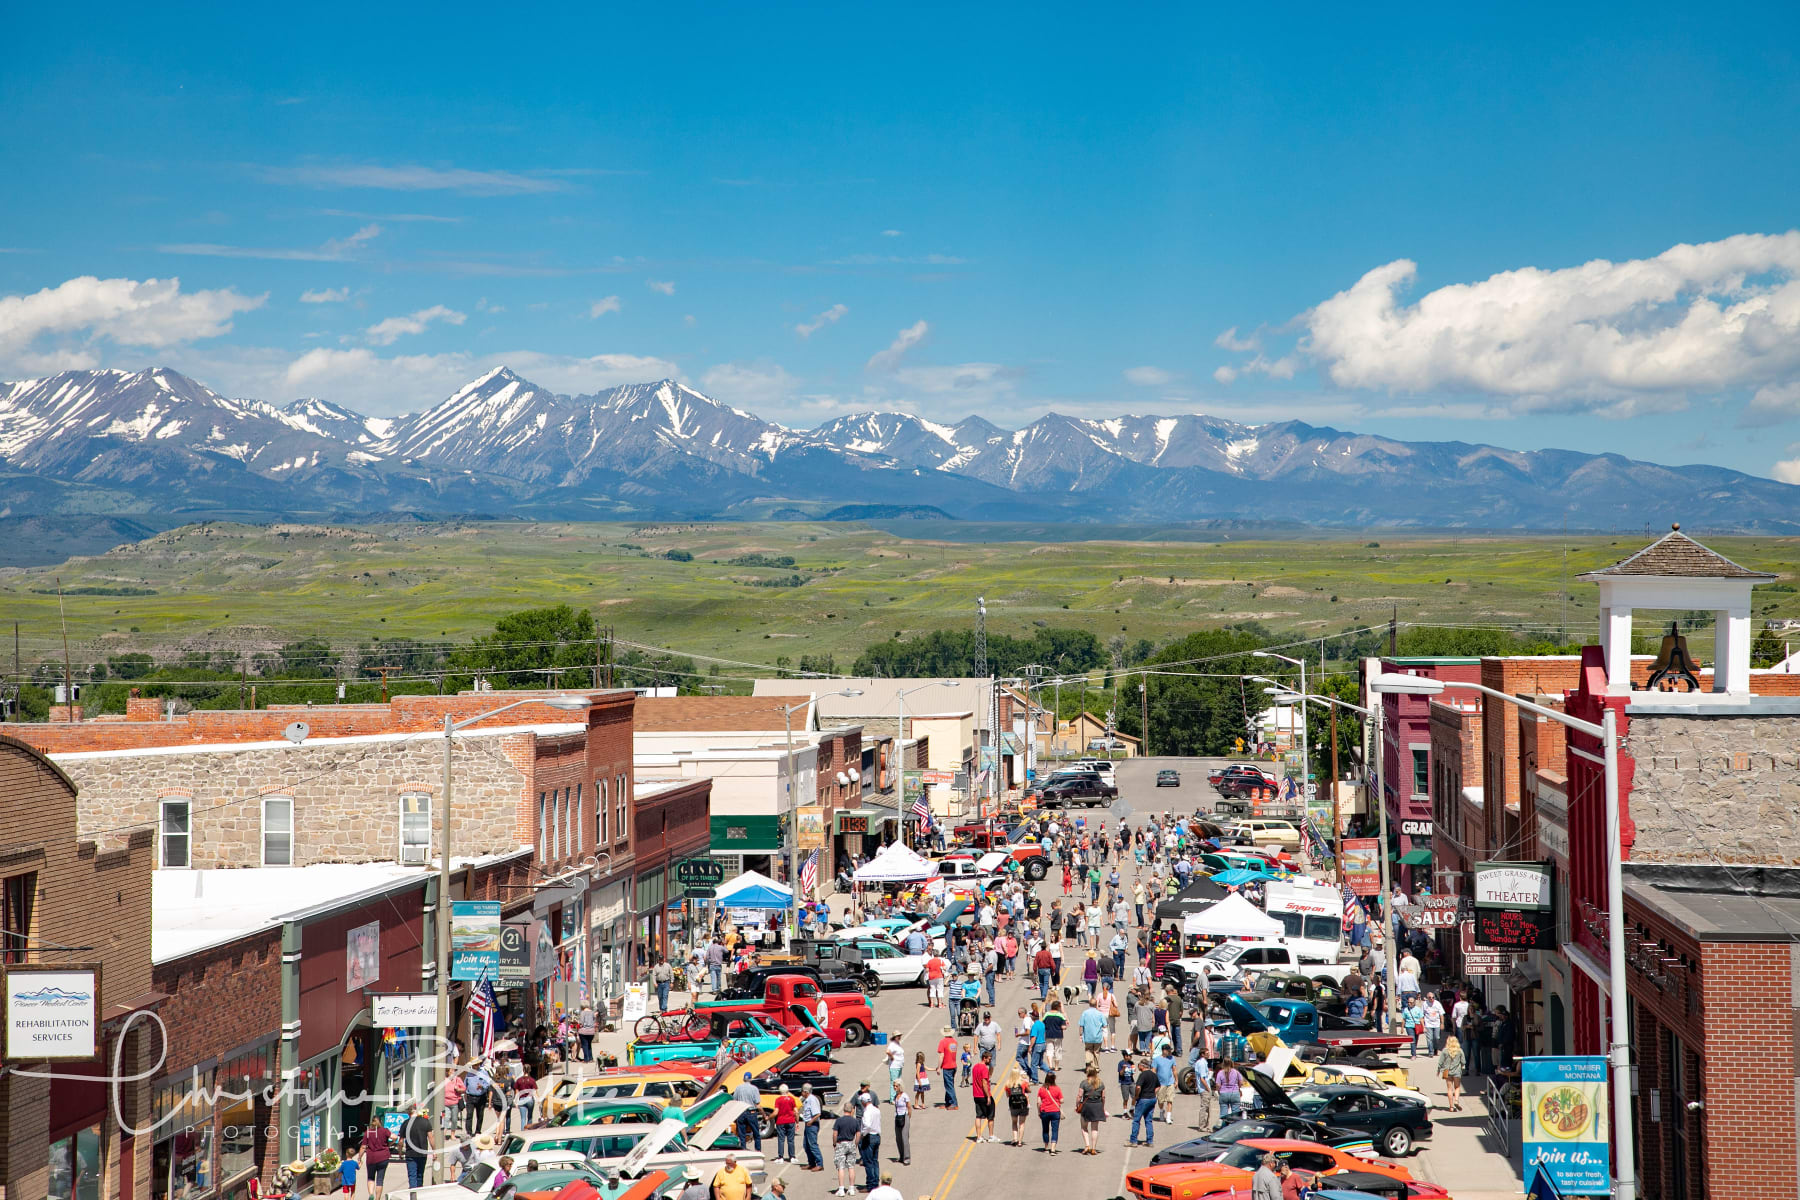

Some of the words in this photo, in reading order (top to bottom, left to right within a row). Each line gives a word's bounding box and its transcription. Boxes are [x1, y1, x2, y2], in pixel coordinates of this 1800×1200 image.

[840, 816, 867, 832] 11:33
[1350, 876, 1363, 884] Join
[1479, 870, 1502, 882] SWEET
[1504, 870, 1528, 878] GRASS
[1529, 873, 1548, 885] ARTS
[1486, 890, 1540, 903] THEATER
[1285, 902, 1326, 913] Snap-on
[1500, 912, 1523, 921] HOURS
[1503, 928, 1521, 936] Thur
[1525, 928, 1531, 936] @
[506, 933, 519, 945] 21
[1489, 935, 1518, 944] Sunday
[1520, 936, 1527, 944] @
[1530, 936, 1536, 945] 5
[456, 953, 478, 964] Join
[40, 999, 67, 1007] Medical
[67, 999, 88, 1007] Center
[15, 1019, 89, 1028] REHABILITATION
[32, 1033, 73, 1042] SERVICES
[1529, 1146, 1566, 1166] Join
